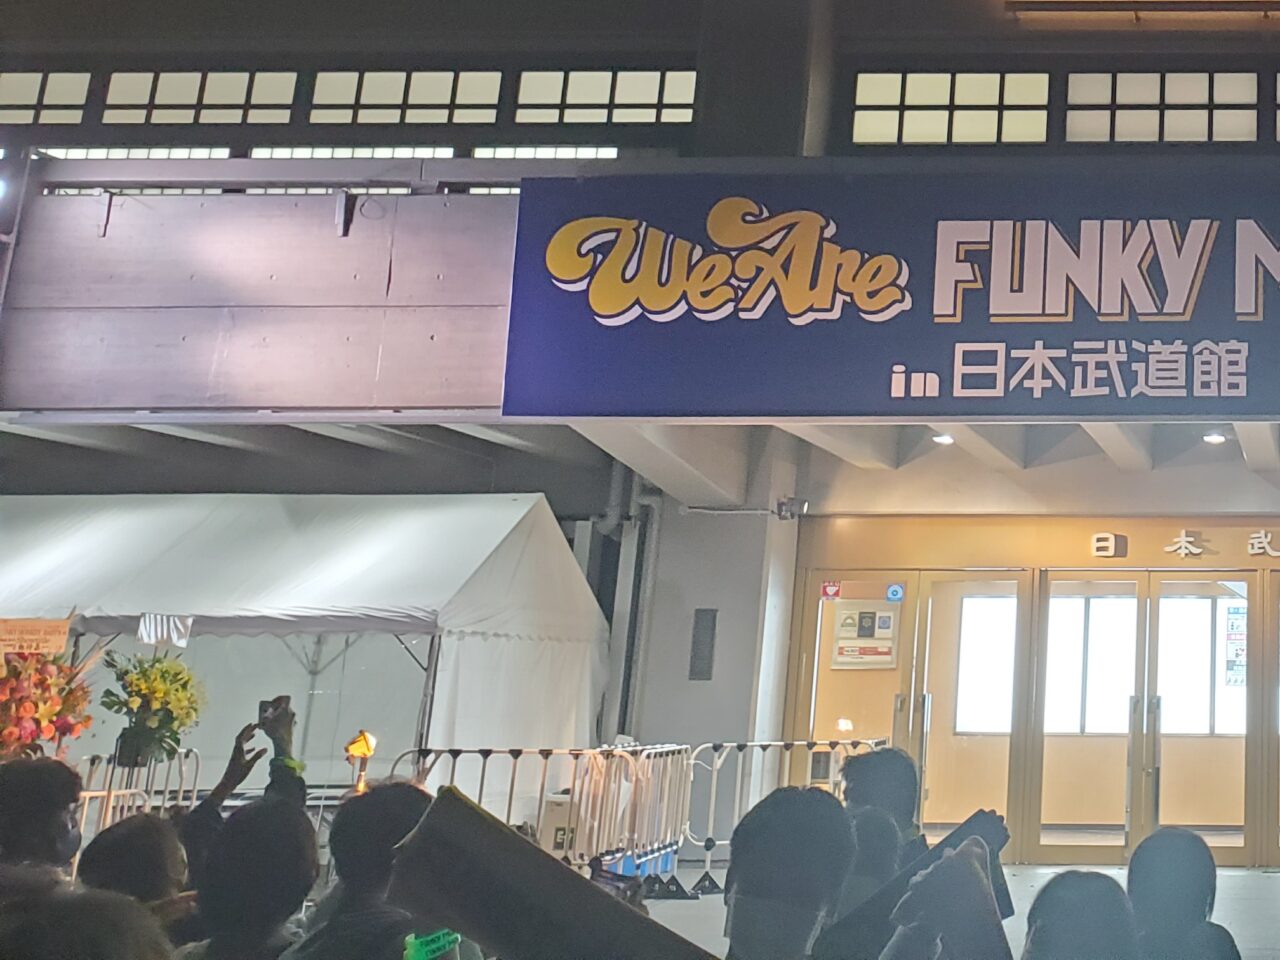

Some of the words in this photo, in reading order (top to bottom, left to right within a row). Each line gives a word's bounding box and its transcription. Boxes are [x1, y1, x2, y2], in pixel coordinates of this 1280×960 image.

[545, 216, 742, 326] We
[707, 197, 912, 326] Are
[933, 219, 1217, 323] FUNKY
[890, 364, 940, 398] in
[951, 340, 1250, 399] 日本武道館
